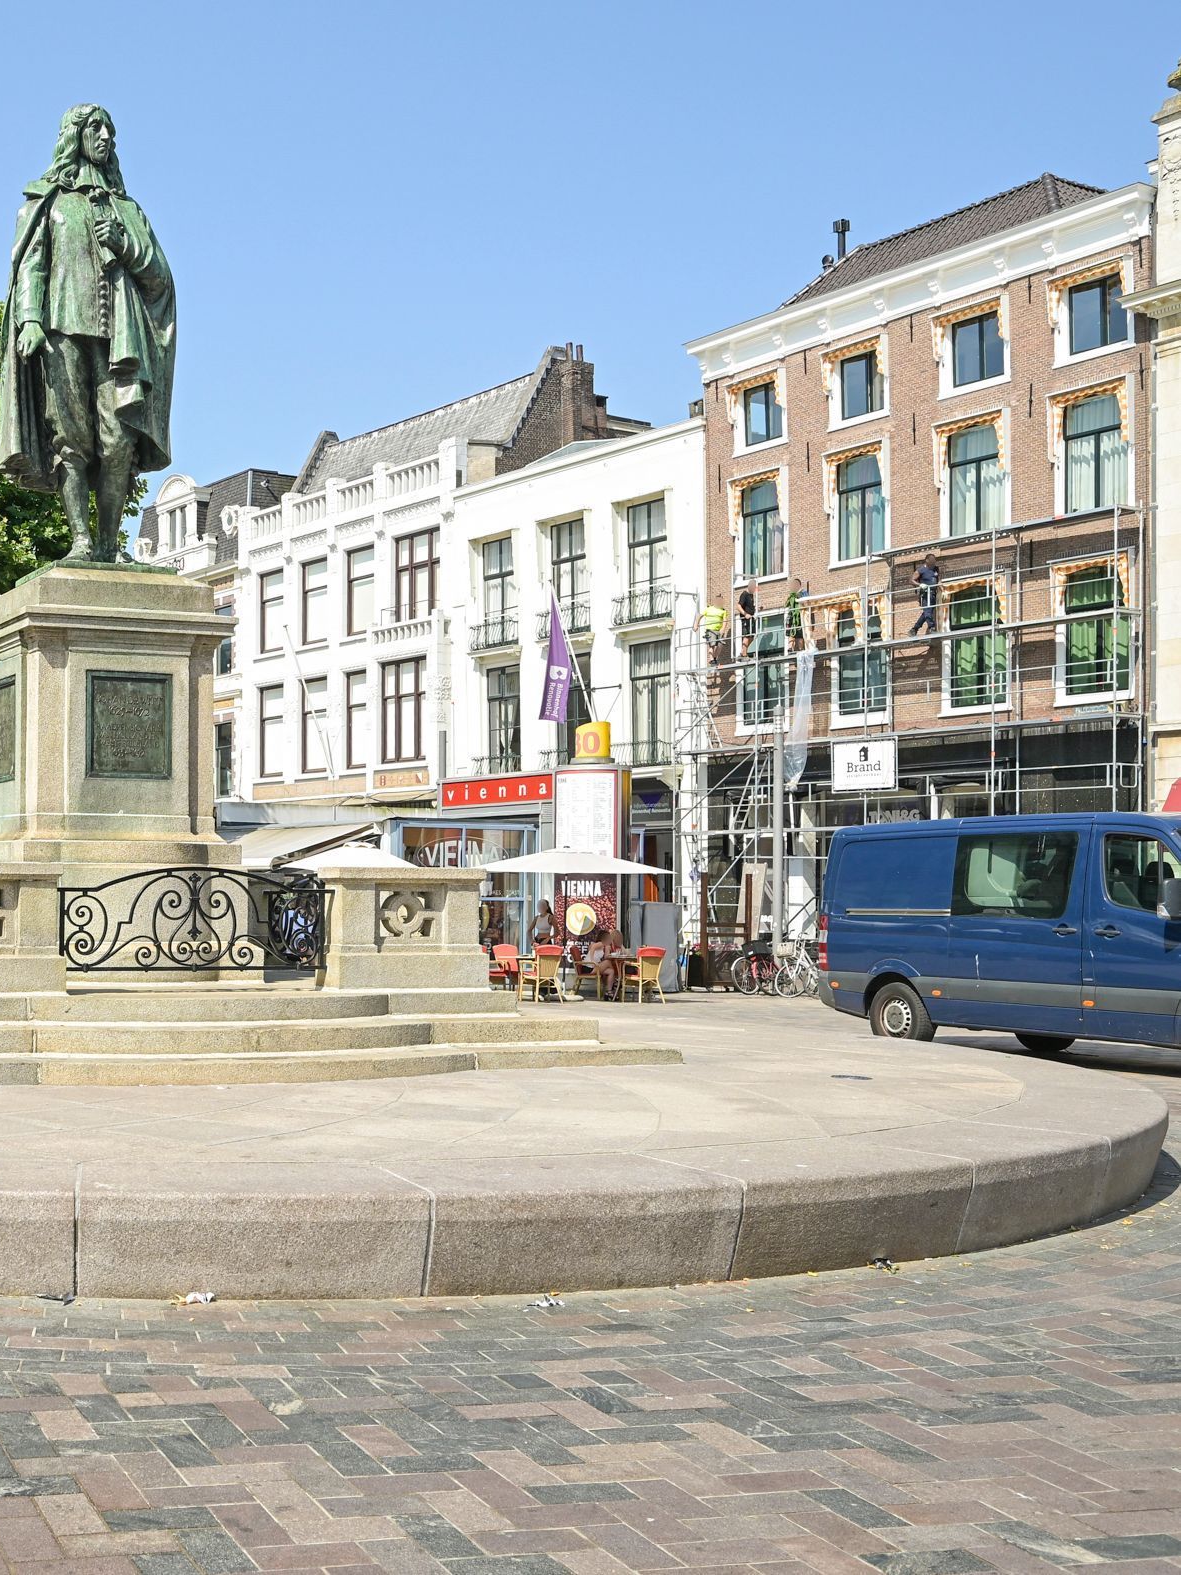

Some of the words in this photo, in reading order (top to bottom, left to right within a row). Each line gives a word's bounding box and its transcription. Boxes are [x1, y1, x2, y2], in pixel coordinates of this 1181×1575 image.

[544, 682, 556, 716] Renovatie
[551, 683, 564, 719] Binnenhof
[846, 760, 882, 773] Brand
[447, 782, 548, 801] vienna
[425, 840, 502, 868] VIENNA
[561, 880, 602, 897] VIENNA
